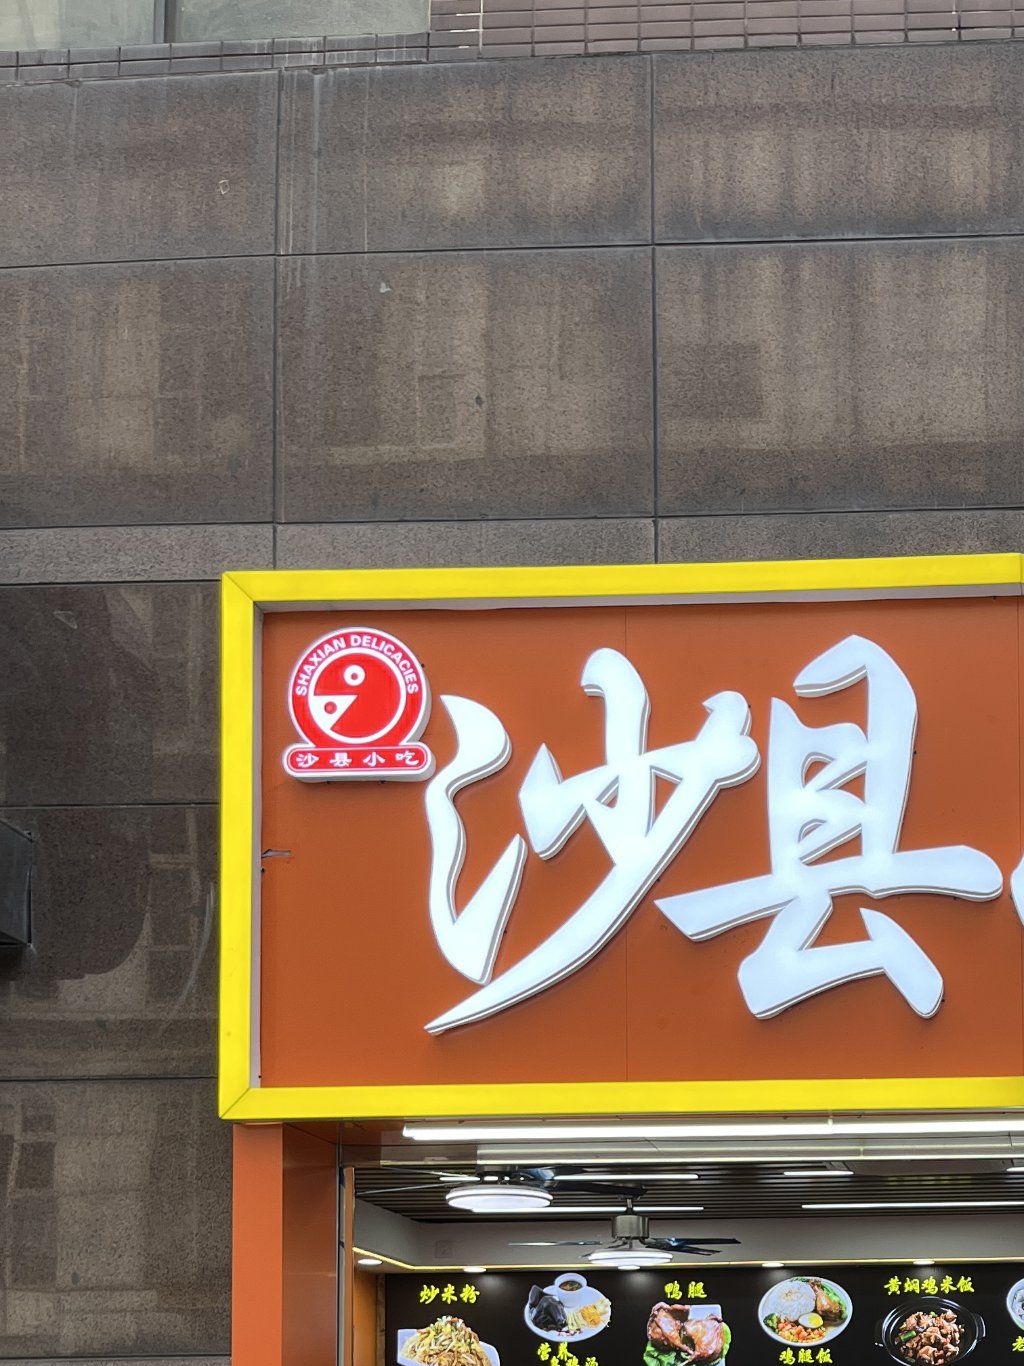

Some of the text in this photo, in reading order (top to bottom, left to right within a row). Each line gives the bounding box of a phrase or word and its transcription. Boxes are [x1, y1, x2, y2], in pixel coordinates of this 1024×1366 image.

[295, 634, 419, 697] SHAXIAN DELICACIES
[295, 751, 419, 768] 沙县小吃
[419, 1283, 480, 1304] 炒米粉
[664, 1280, 707, 1300] 鸭腿
[884, 1275, 975, 1295] 黄焖鸡米饭
[537, 1342, 573, 1361] 营养
[779, 1347, 833, 1365] 鸡腿饭
